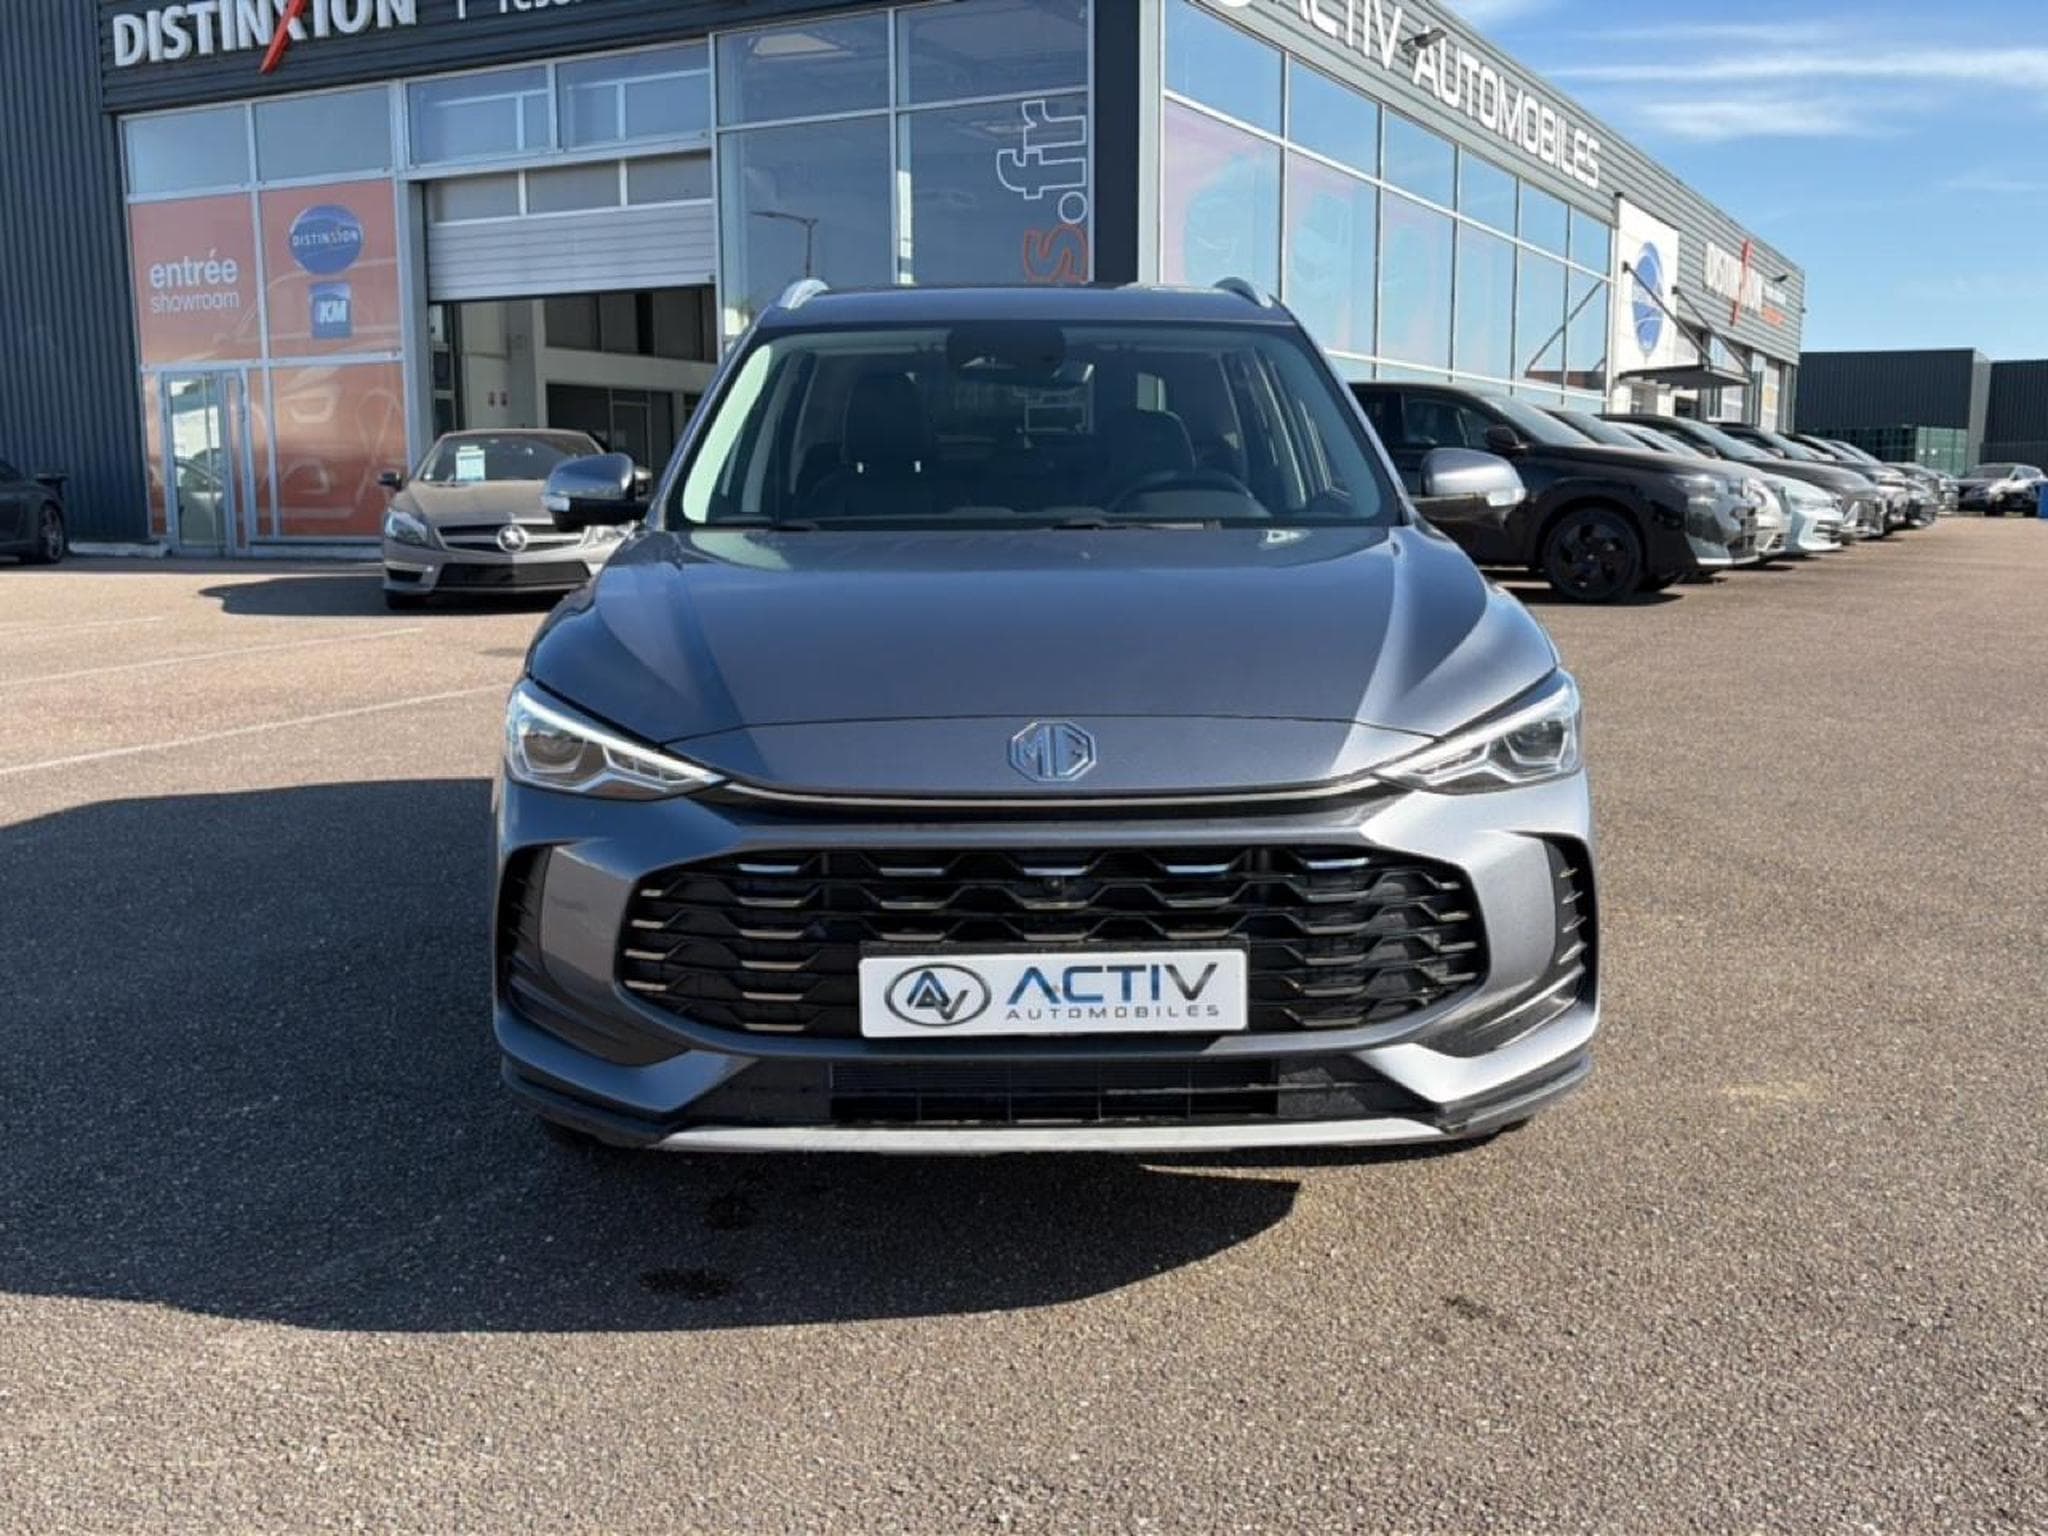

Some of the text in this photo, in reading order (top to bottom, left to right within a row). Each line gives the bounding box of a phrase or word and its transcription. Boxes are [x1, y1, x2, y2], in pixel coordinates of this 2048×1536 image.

[113, 0, 417, 76] DISTINXION
[1412, 26, 1600, 189] AUTOMOBILES
[150, 248, 238, 288] entrée
[151, 291, 240, 314] showroom
[1006, 962, 1219, 1005] ACTIV
[1006, 1003, 1220, 1021] AUTOMOBILES
